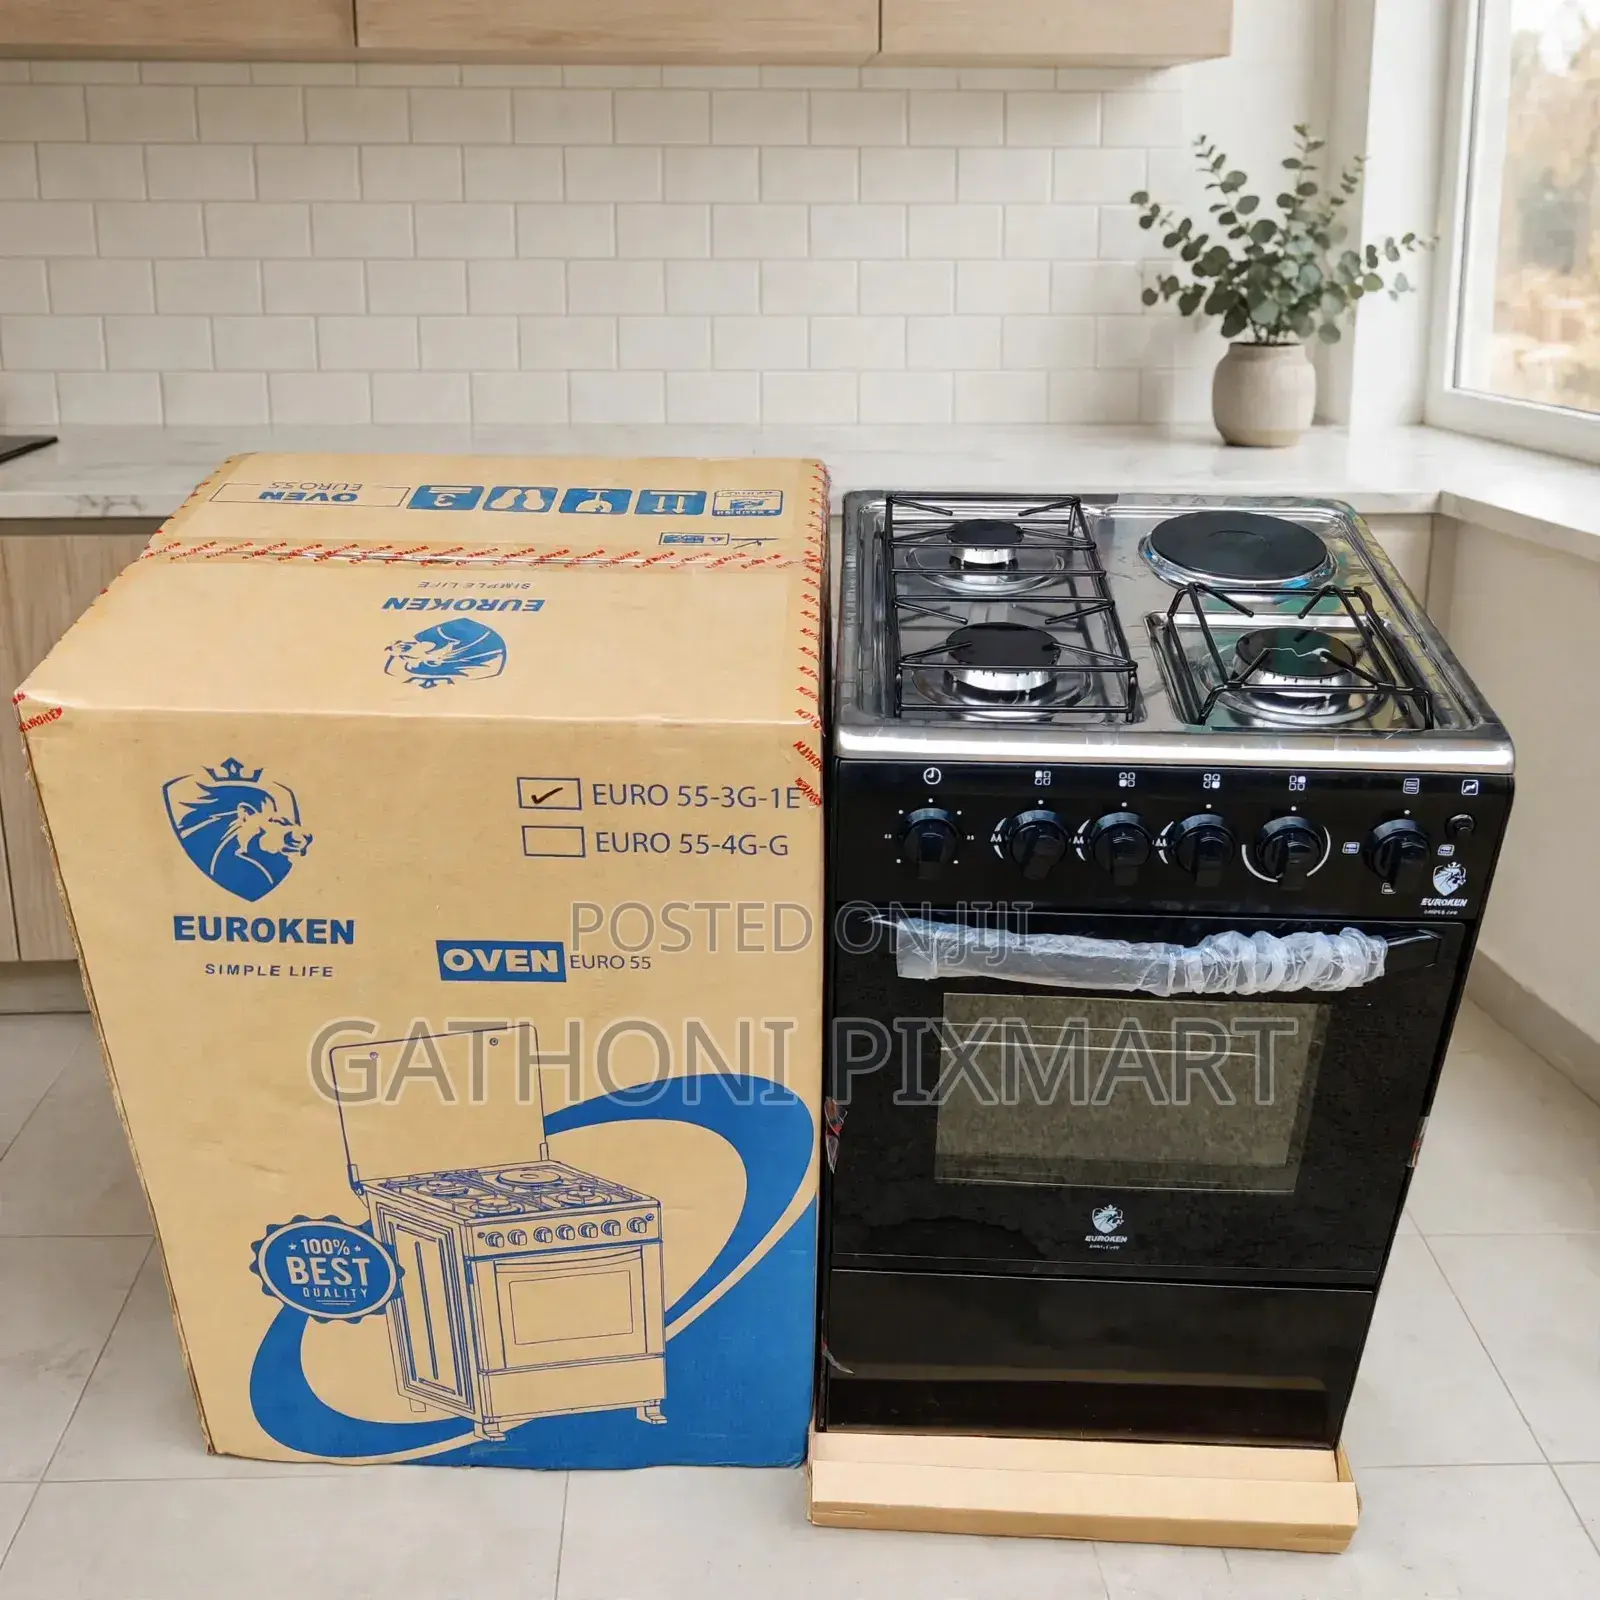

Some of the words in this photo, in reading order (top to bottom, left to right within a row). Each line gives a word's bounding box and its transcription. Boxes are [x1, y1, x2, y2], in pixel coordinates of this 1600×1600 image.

[299, 482, 363, 491] EURO
[258, 491, 358, 502] OVEN
[433, 493, 457, 507] 3
[417, 581, 458, 589] LIFE
[463, 582, 531, 590] SIMPLE
[381, 597, 546, 612] EUROKEN
[592, 783, 669, 807] EURO
[677, 785, 801, 809] 55-3G-1E
[595, 831, 671, 854] EURO
[678, 833, 788, 857] 55-4G-G
[173, 915, 355, 945] EUROKEN
[442, 948, 559, 974] OVEN
[570, 954, 626, 970] EURO
[630, 955, 652, 970] 55
[204, 963, 281, 977] SIMPLE
[289, 965, 334, 978] LIFE
[300, 1238, 351, 1256] 100%
[285, 1256, 371, 1287] BEST
[302, 1287, 368, 1299] QUALITY
